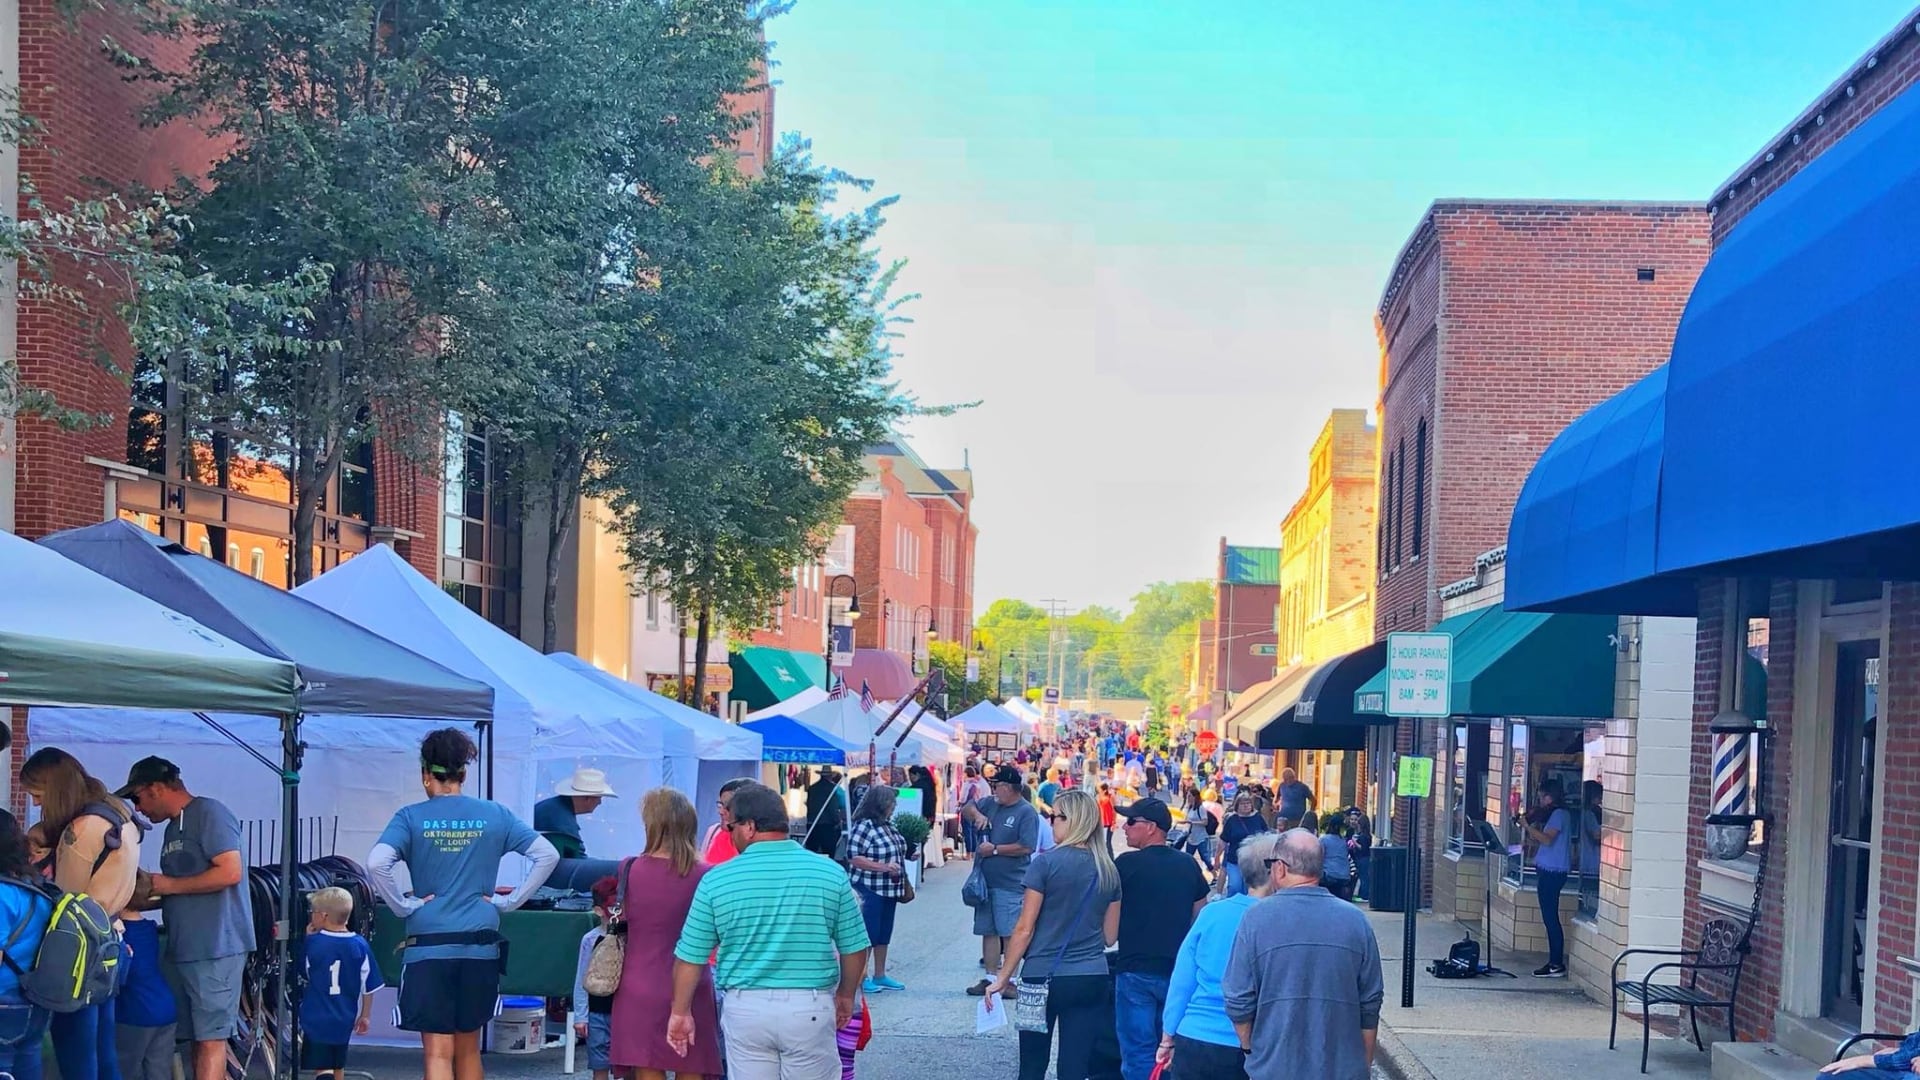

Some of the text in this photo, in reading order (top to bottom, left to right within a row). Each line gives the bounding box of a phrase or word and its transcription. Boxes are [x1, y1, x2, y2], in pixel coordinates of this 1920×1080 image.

[1392, 647, 1448, 660] 2 HOUR PARKING
[1391, 668, 1417, 681] MONDAY
[1425, 669, 1447, 681] FRIDAY
[1398, 687, 1414, 700] 8AM
[1423, 688, 1438, 701] 5PM
[423, 820, 448, 829] DAS
[423, 830, 484, 838] OKTOBERFEST
[329, 959, 341, 995] 1
